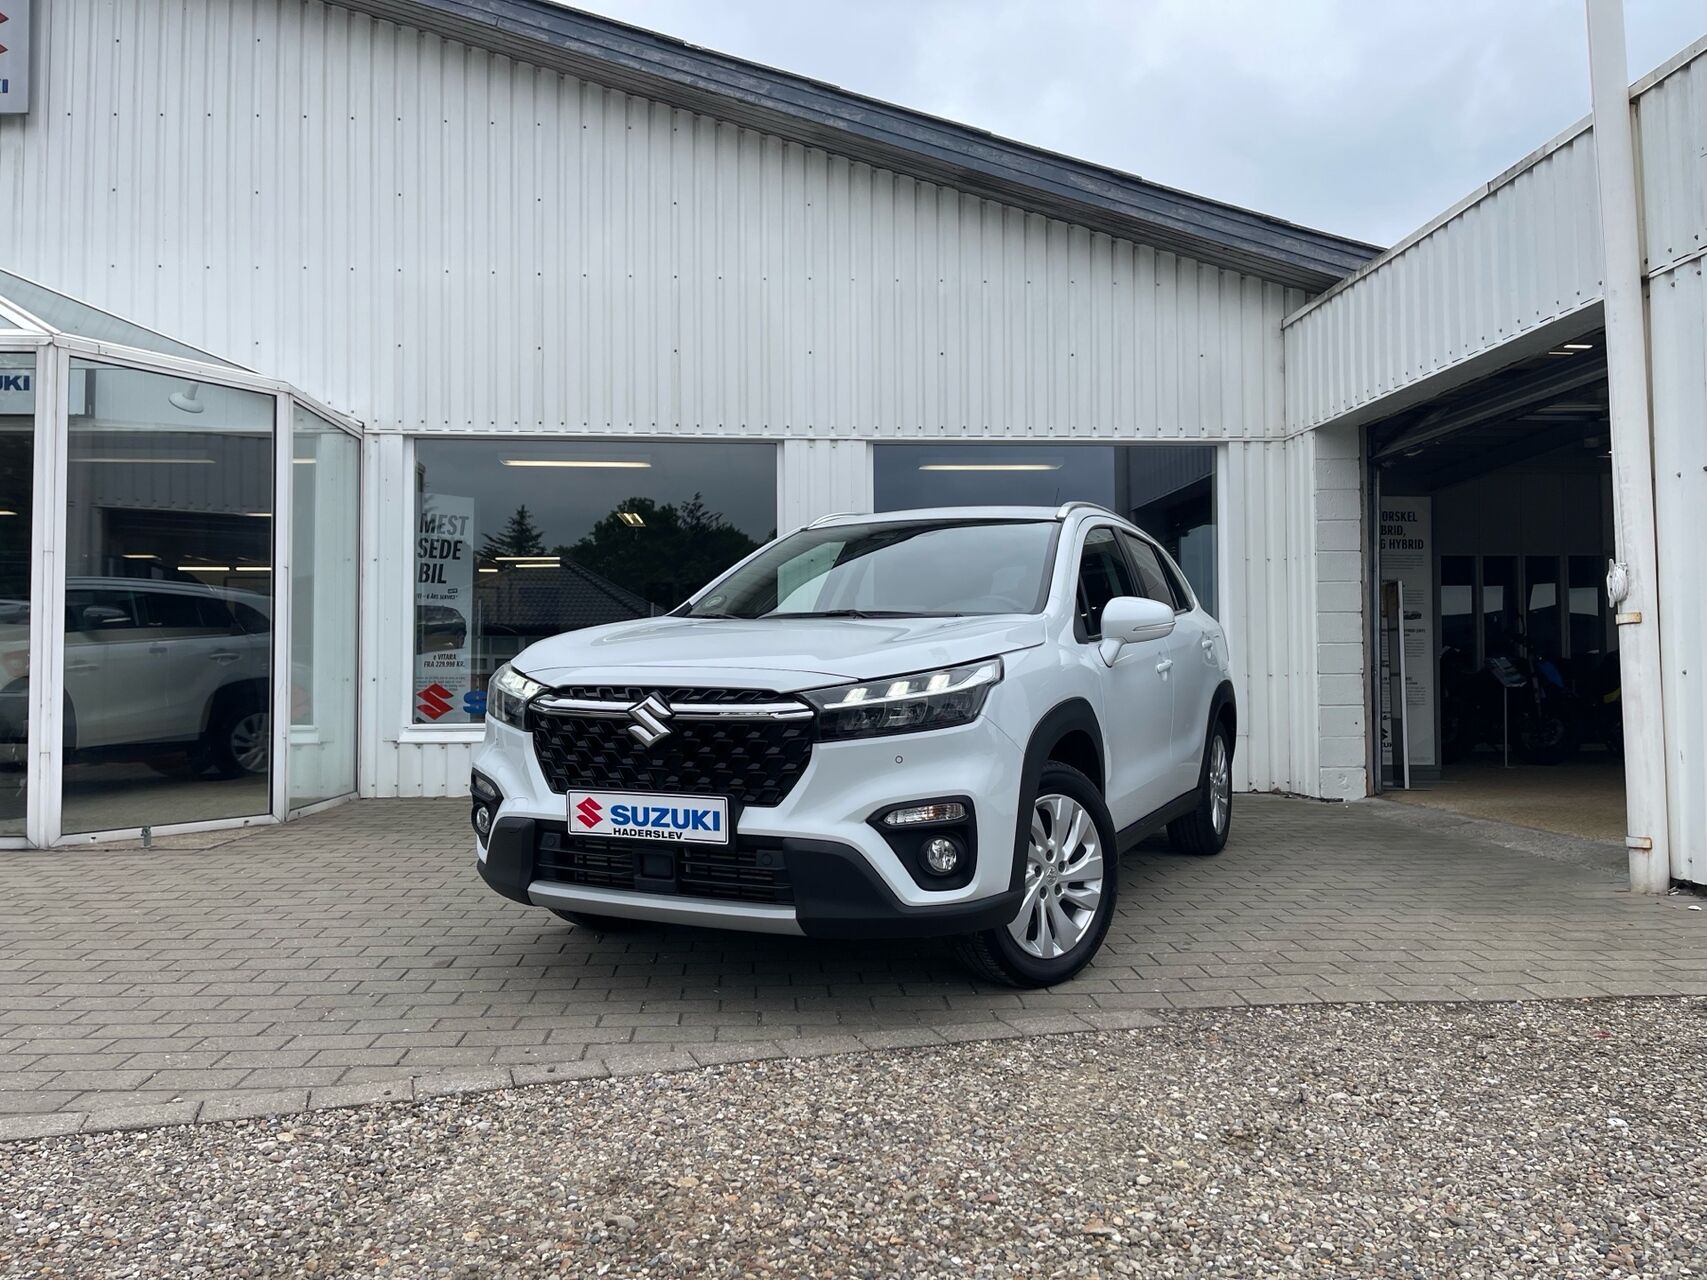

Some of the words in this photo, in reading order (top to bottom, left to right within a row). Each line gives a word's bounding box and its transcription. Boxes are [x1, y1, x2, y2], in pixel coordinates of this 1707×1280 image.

[419, 512, 470, 537] MEST
[417, 537, 463, 561] SEDE
[1389, 539, 1424, 550] HYBRID
[417, 562, 447, 585] BIL
[610, 805, 720, 832] SUZUKI
[613, 828, 683, 840] HADERSLEV
